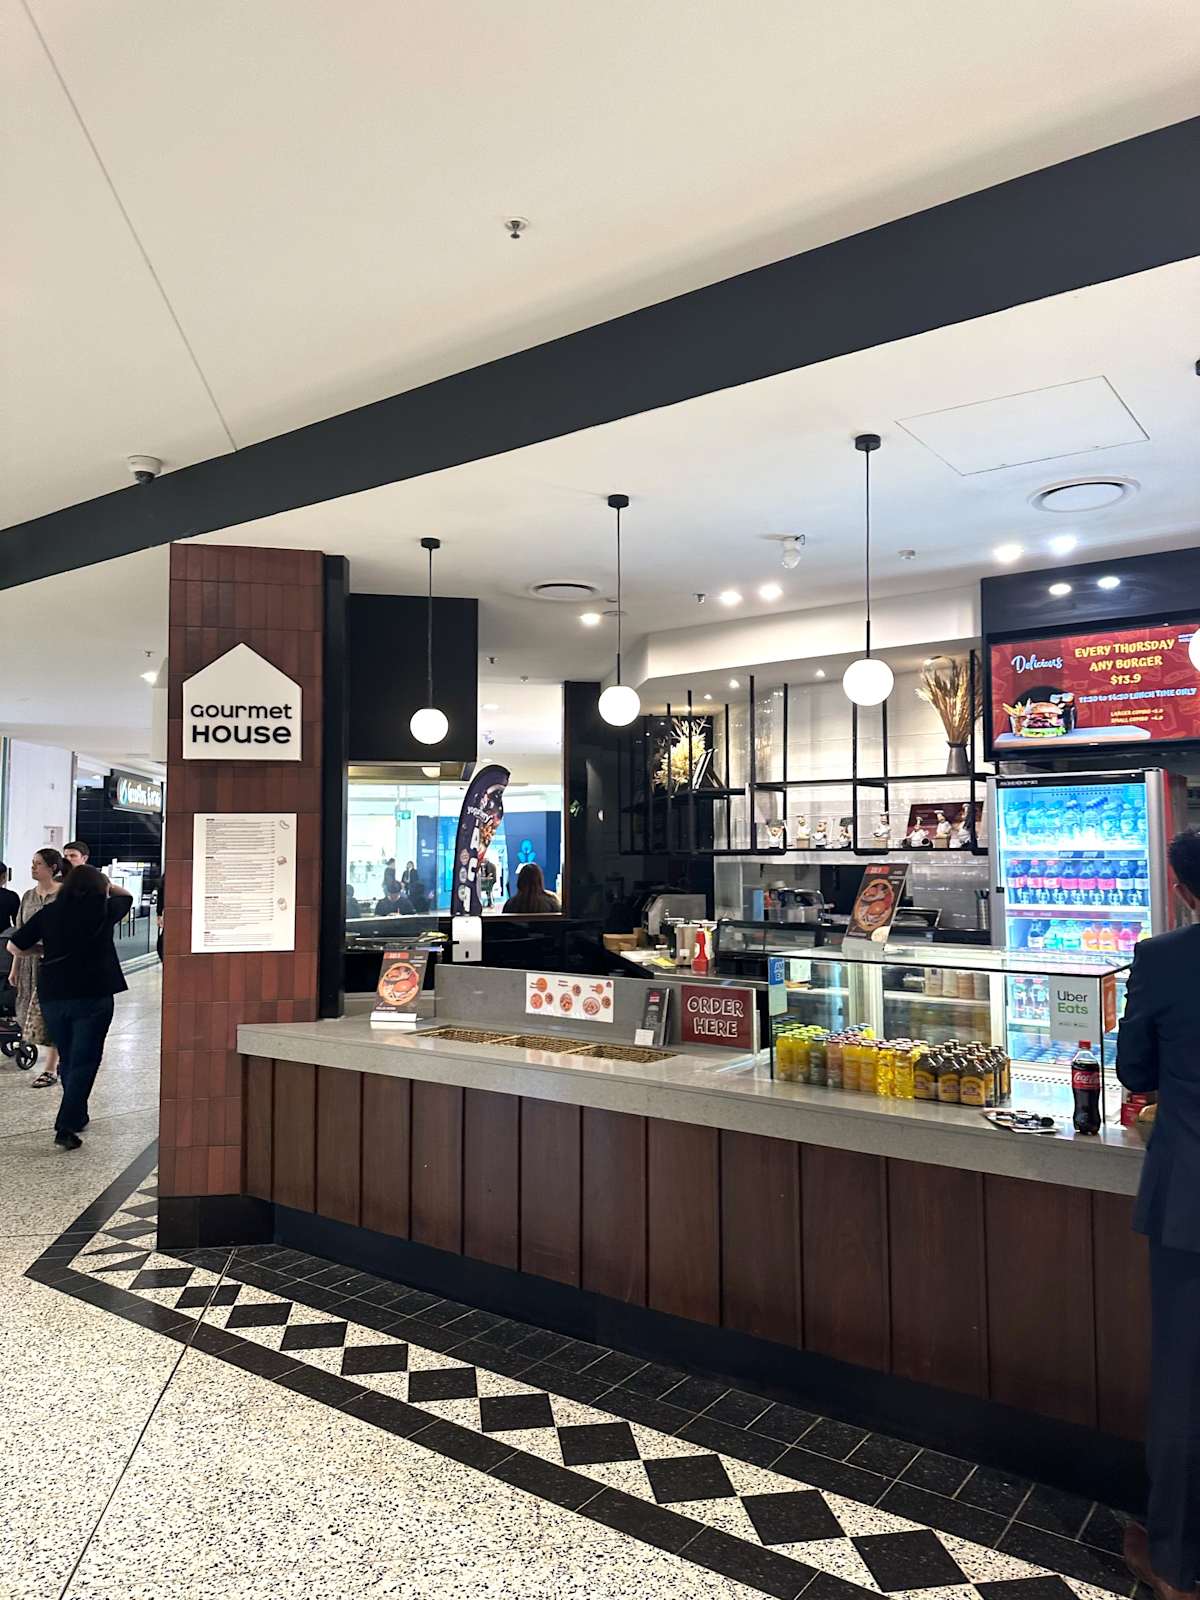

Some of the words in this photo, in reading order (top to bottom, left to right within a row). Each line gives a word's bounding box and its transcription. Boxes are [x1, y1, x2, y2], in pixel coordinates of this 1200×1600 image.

[1074, 645, 1111, 658] EVERY
[1112, 638, 1175, 654] THURSDAY
[1011, 654, 1063, 674] Delicious
[1089, 660, 1113, 672] ANY
[1115, 655, 1164, 669] BURGER
[1110, 673, 1142, 686] $13.9
[1056, 990, 1088, 1003] Uber
[687, 996, 744, 1018] ORDER
[1057, 1002, 1089, 1015] Eats
[693, 1016, 738, 1038] HERE
